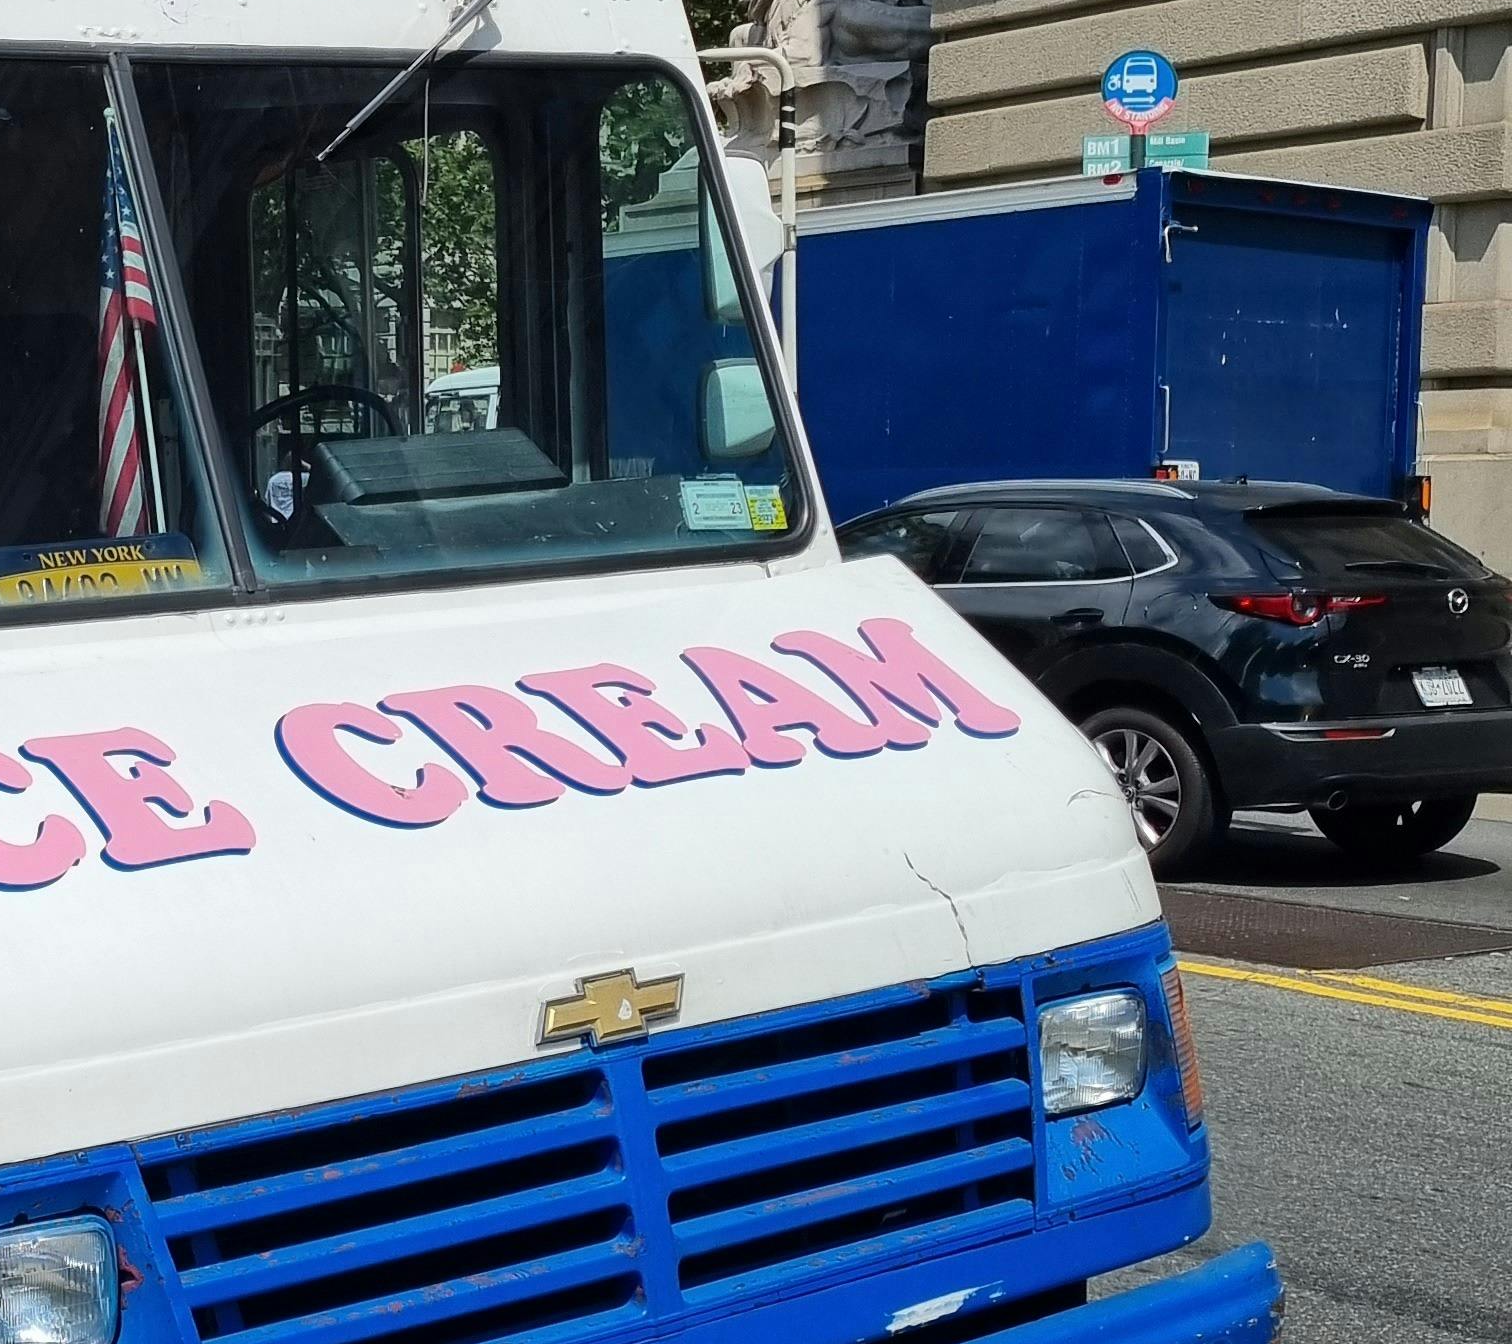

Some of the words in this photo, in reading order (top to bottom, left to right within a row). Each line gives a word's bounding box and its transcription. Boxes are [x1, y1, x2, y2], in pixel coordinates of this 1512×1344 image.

[1087, 139, 1120, 155] BM1
[1087, 160, 1122, 176] BM2
[692, 502, 700, 514] 2
[730, 502, 742, 514] 23
[38, 549, 87, 569] NEW
[90, 544, 145, 564] YORK
[274, 616, 1021, 830] CREAM
